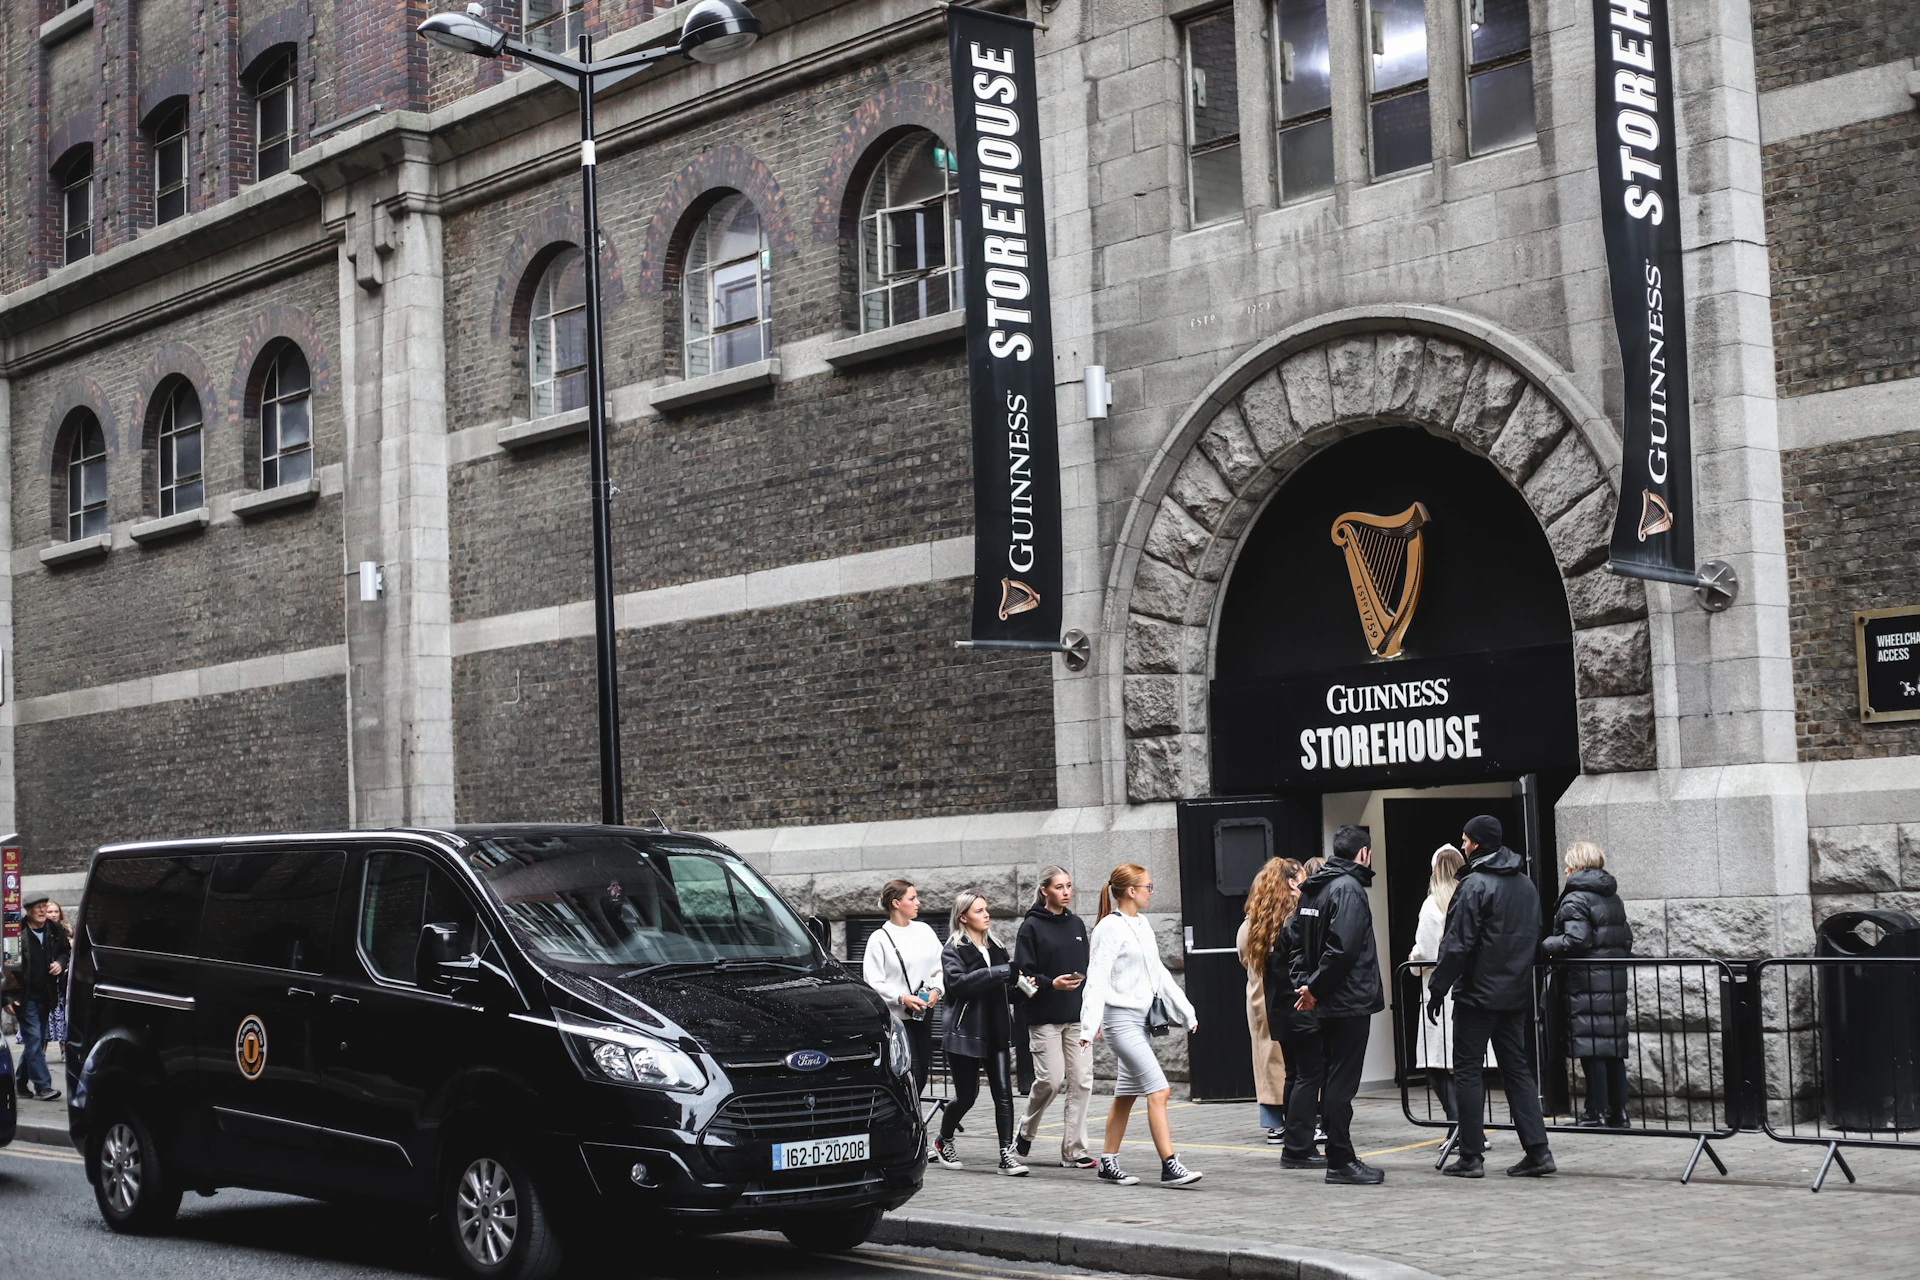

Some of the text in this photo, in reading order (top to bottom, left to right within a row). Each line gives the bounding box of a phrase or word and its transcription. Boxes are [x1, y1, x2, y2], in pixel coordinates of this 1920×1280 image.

[1609, 0, 1664, 226] STOREH
[970, 42, 1033, 363] STOREHOUSE
[1646, 264, 1668, 485] GUINNESS
[1009, 394, 1034, 573] GUINNESS
[1363, 610, 1378, 638] 1759
[1876, 632, 1920, 647] WHEELCHA
[1877, 647, 1910, 662] ACCESS
[1326, 678, 1449, 715] GUINNESS
[1300, 714, 1482, 771] STOREHOUSE
[797, 1054, 821, 1067] Ford
[786, 1141, 864, 1167] 162-D-20208
